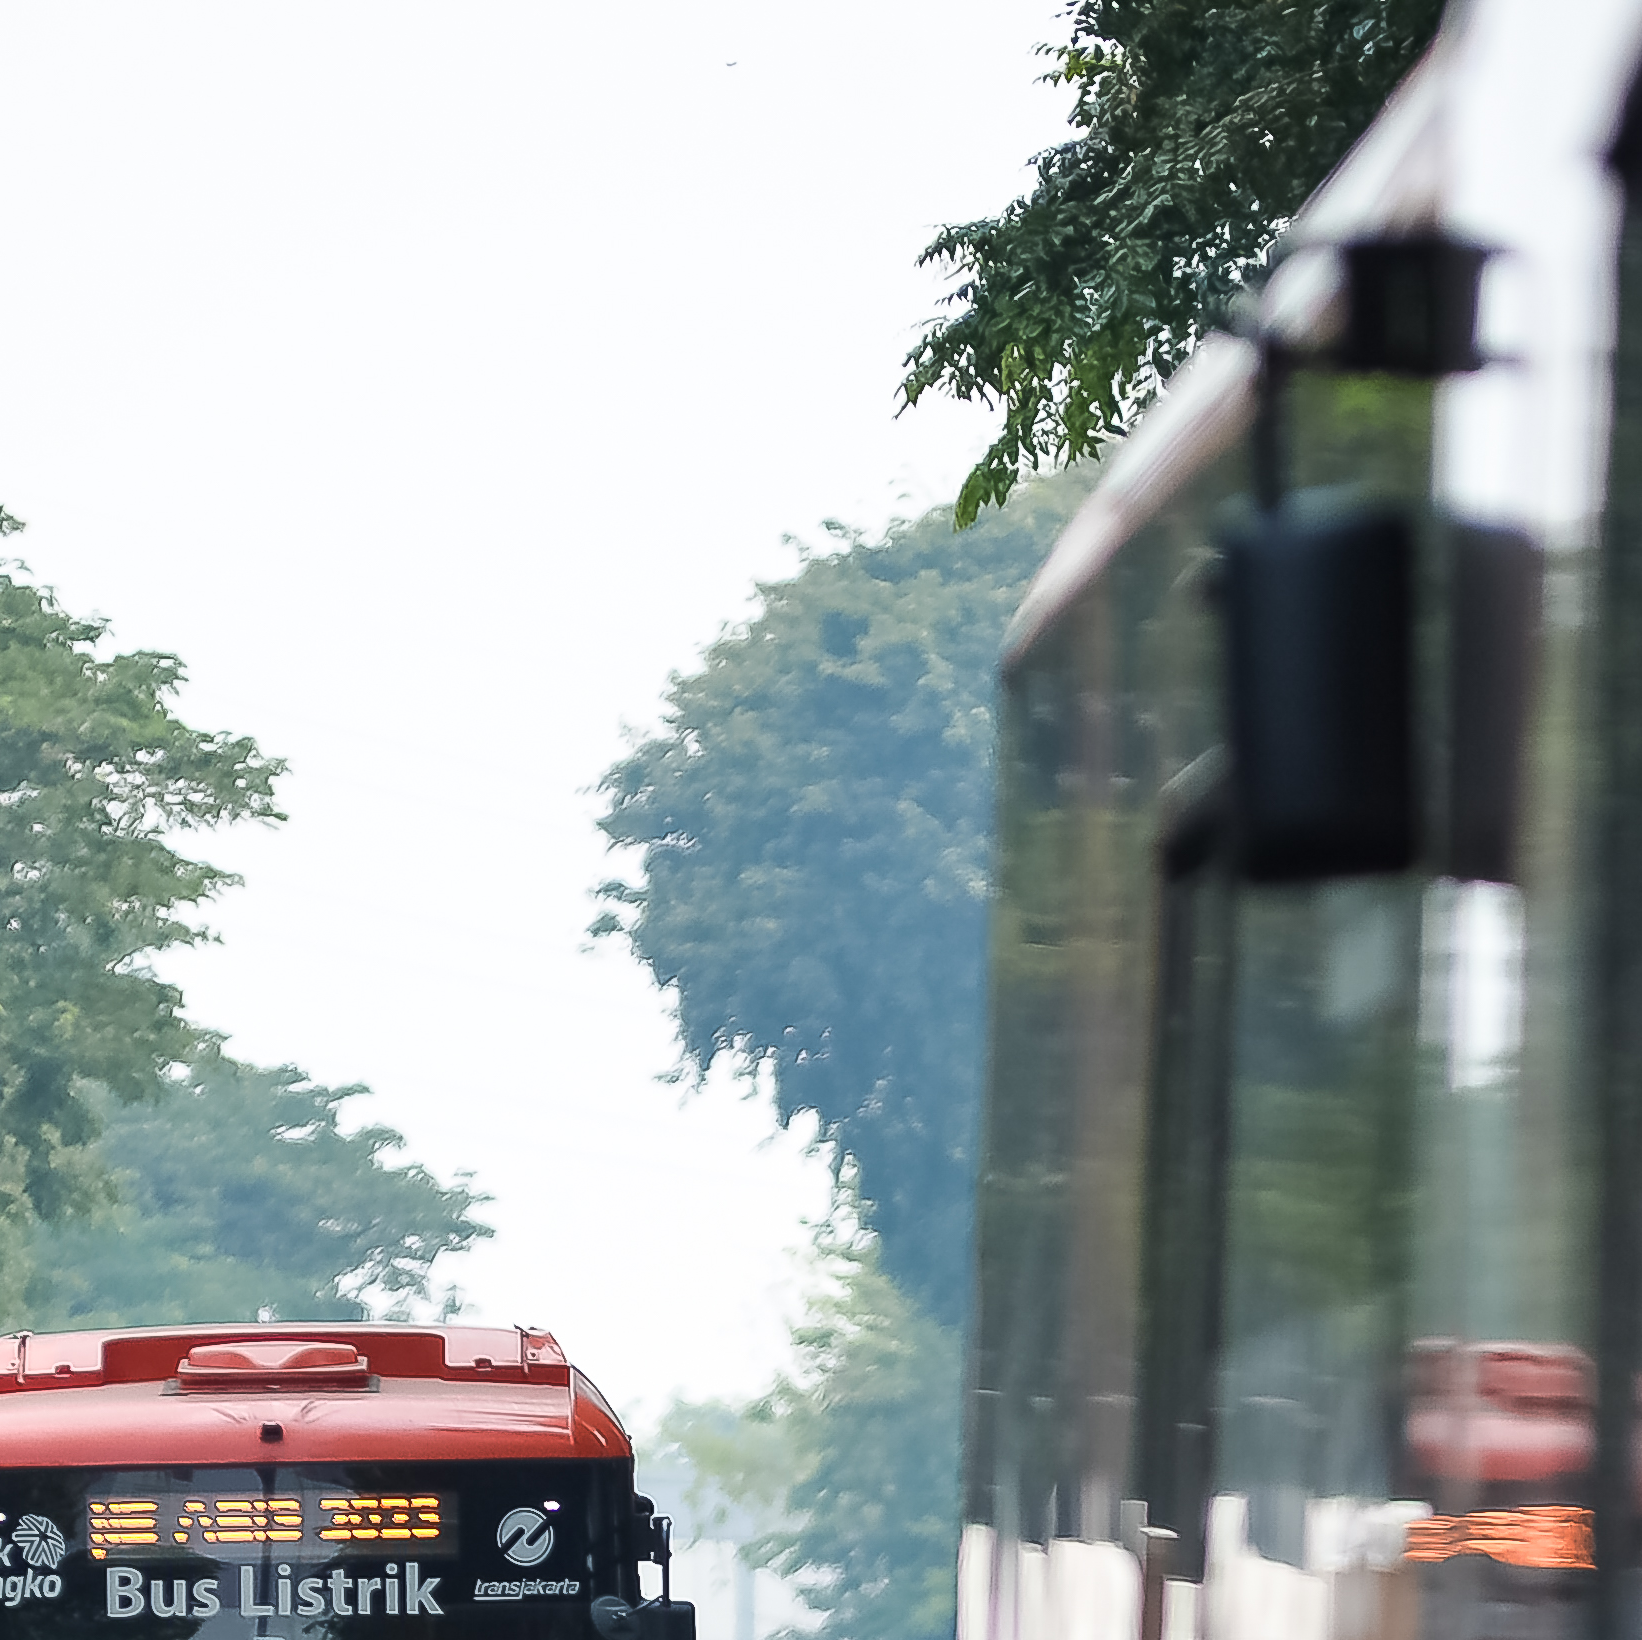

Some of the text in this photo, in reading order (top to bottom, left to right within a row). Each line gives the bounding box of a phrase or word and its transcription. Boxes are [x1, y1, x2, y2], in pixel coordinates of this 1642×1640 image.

[106, 1562, 445, 1618] Bus Listrik
[473, 1578, 580, 1601] transjakarta
